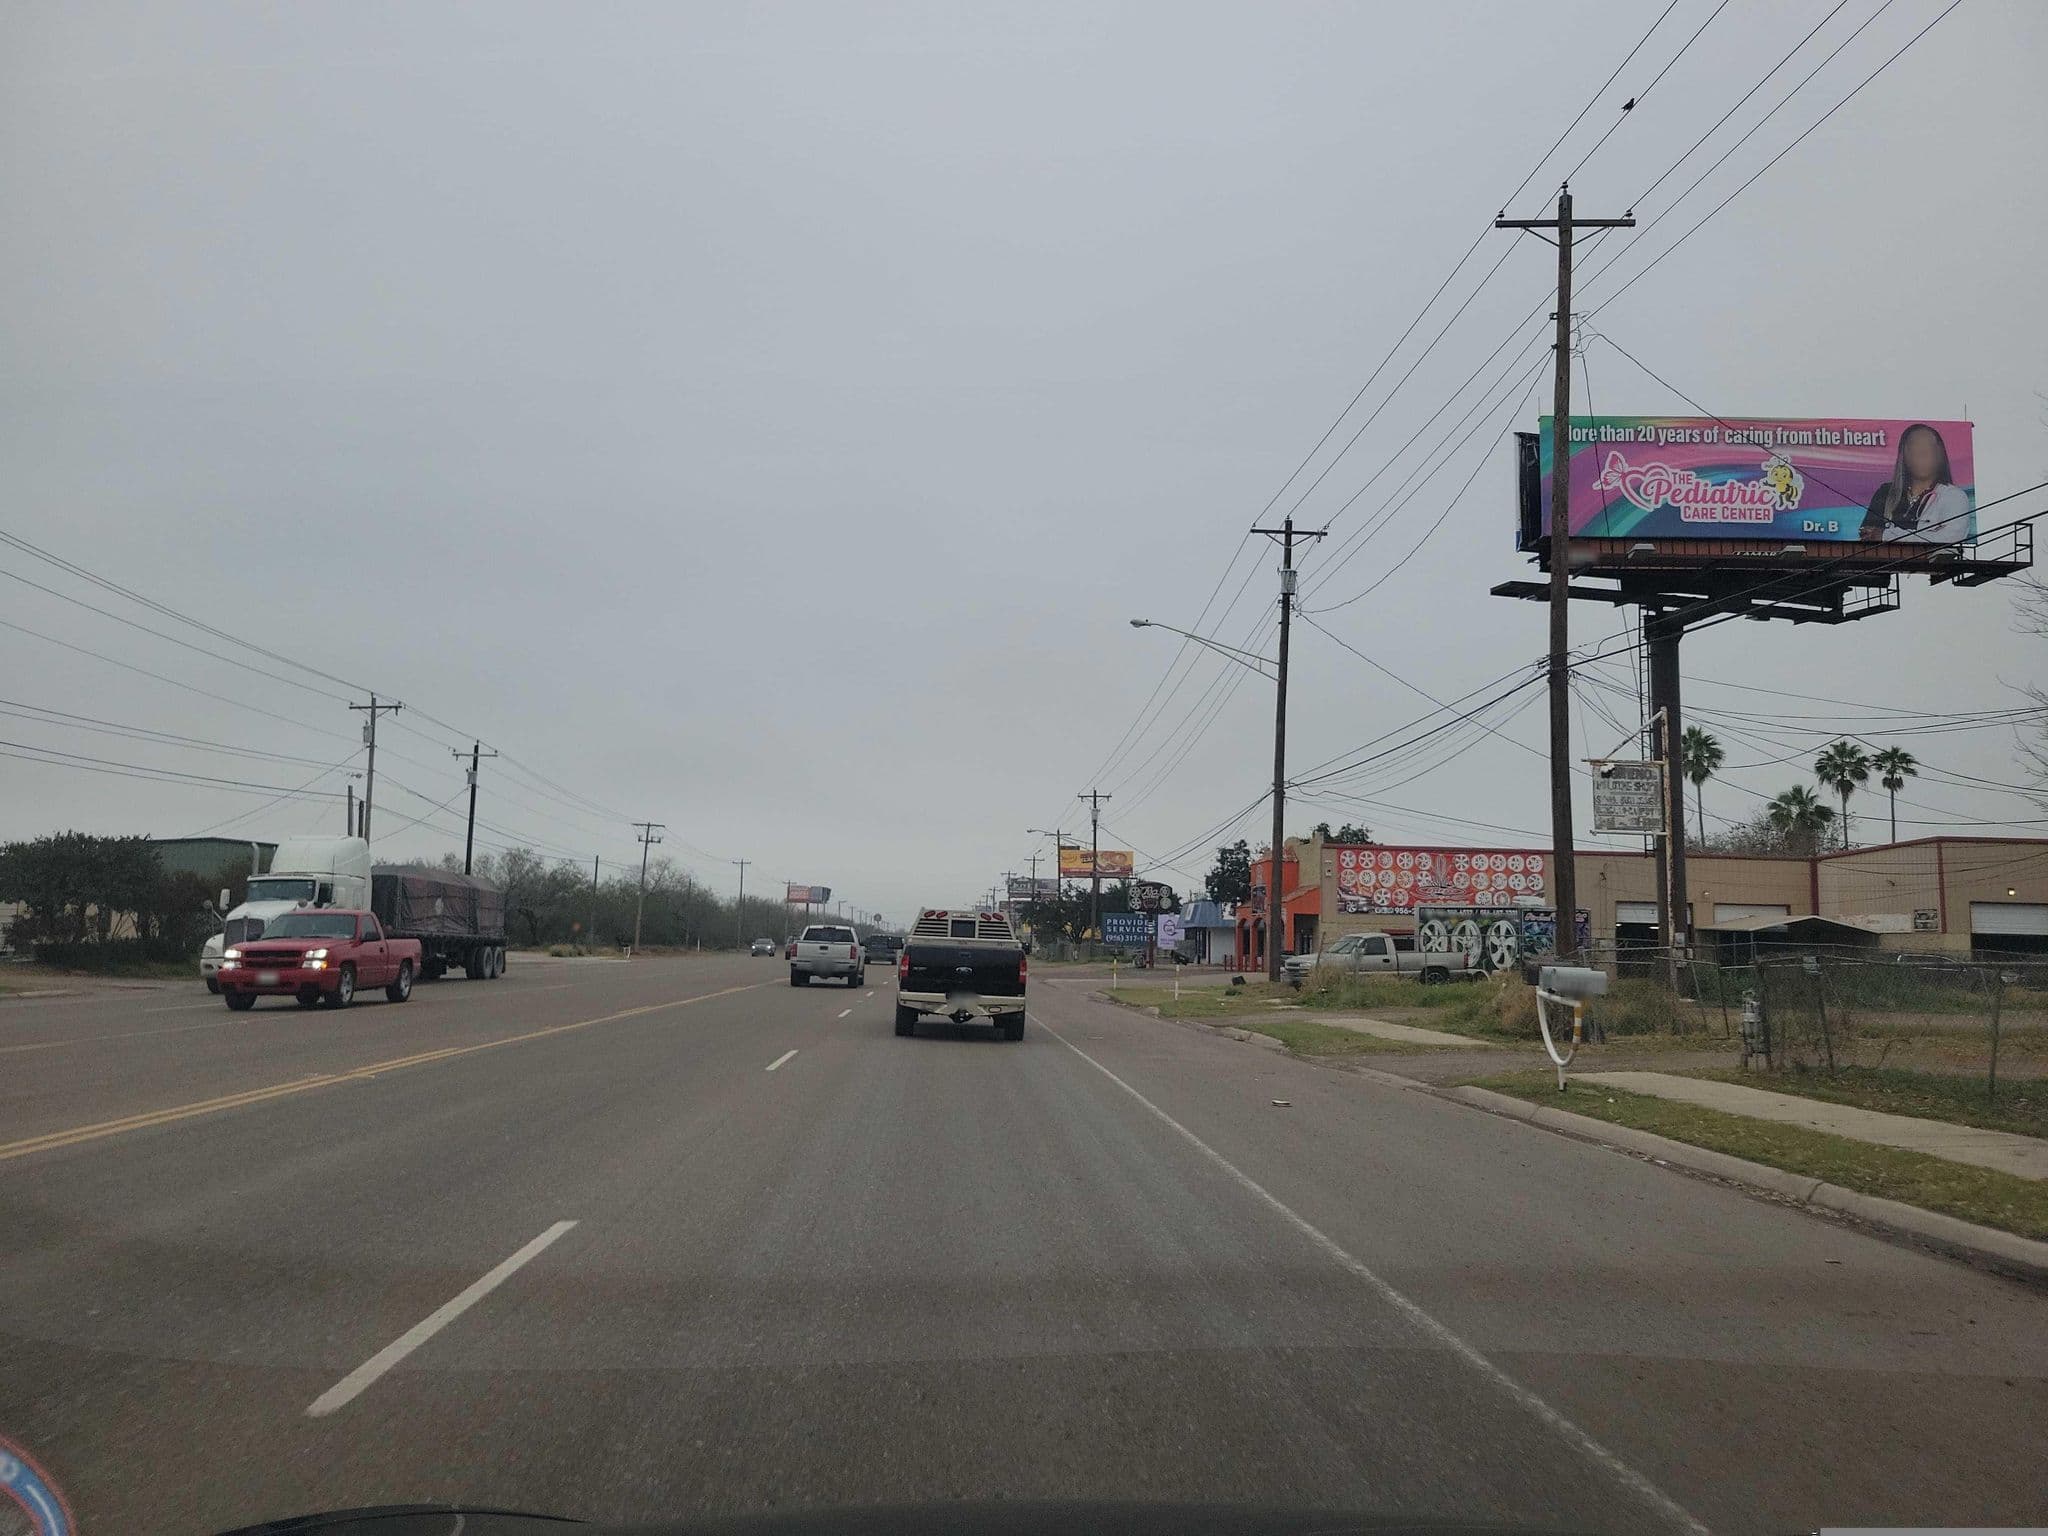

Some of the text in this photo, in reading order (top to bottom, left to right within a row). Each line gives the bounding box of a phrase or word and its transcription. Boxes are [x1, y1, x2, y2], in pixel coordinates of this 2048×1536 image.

[1600, 424, 1634, 442] than
[1637, 425, 1654, 442] 20
[1658, 428, 1700, 446] years
[1703, 425, 1720, 443] of
[1724, 426, 1773, 448] caring
[1775, 427, 1812, 445] from
[1815, 427, 1841, 445] the
[1843, 427, 1887, 446] heart
[1672, 472, 1693, 485] THE
[1643, 478, 1775, 506] Pediatric
[1683, 507, 1772, 521] CARE CENTER
[1803, 520, 1839, 532] Dr. B
